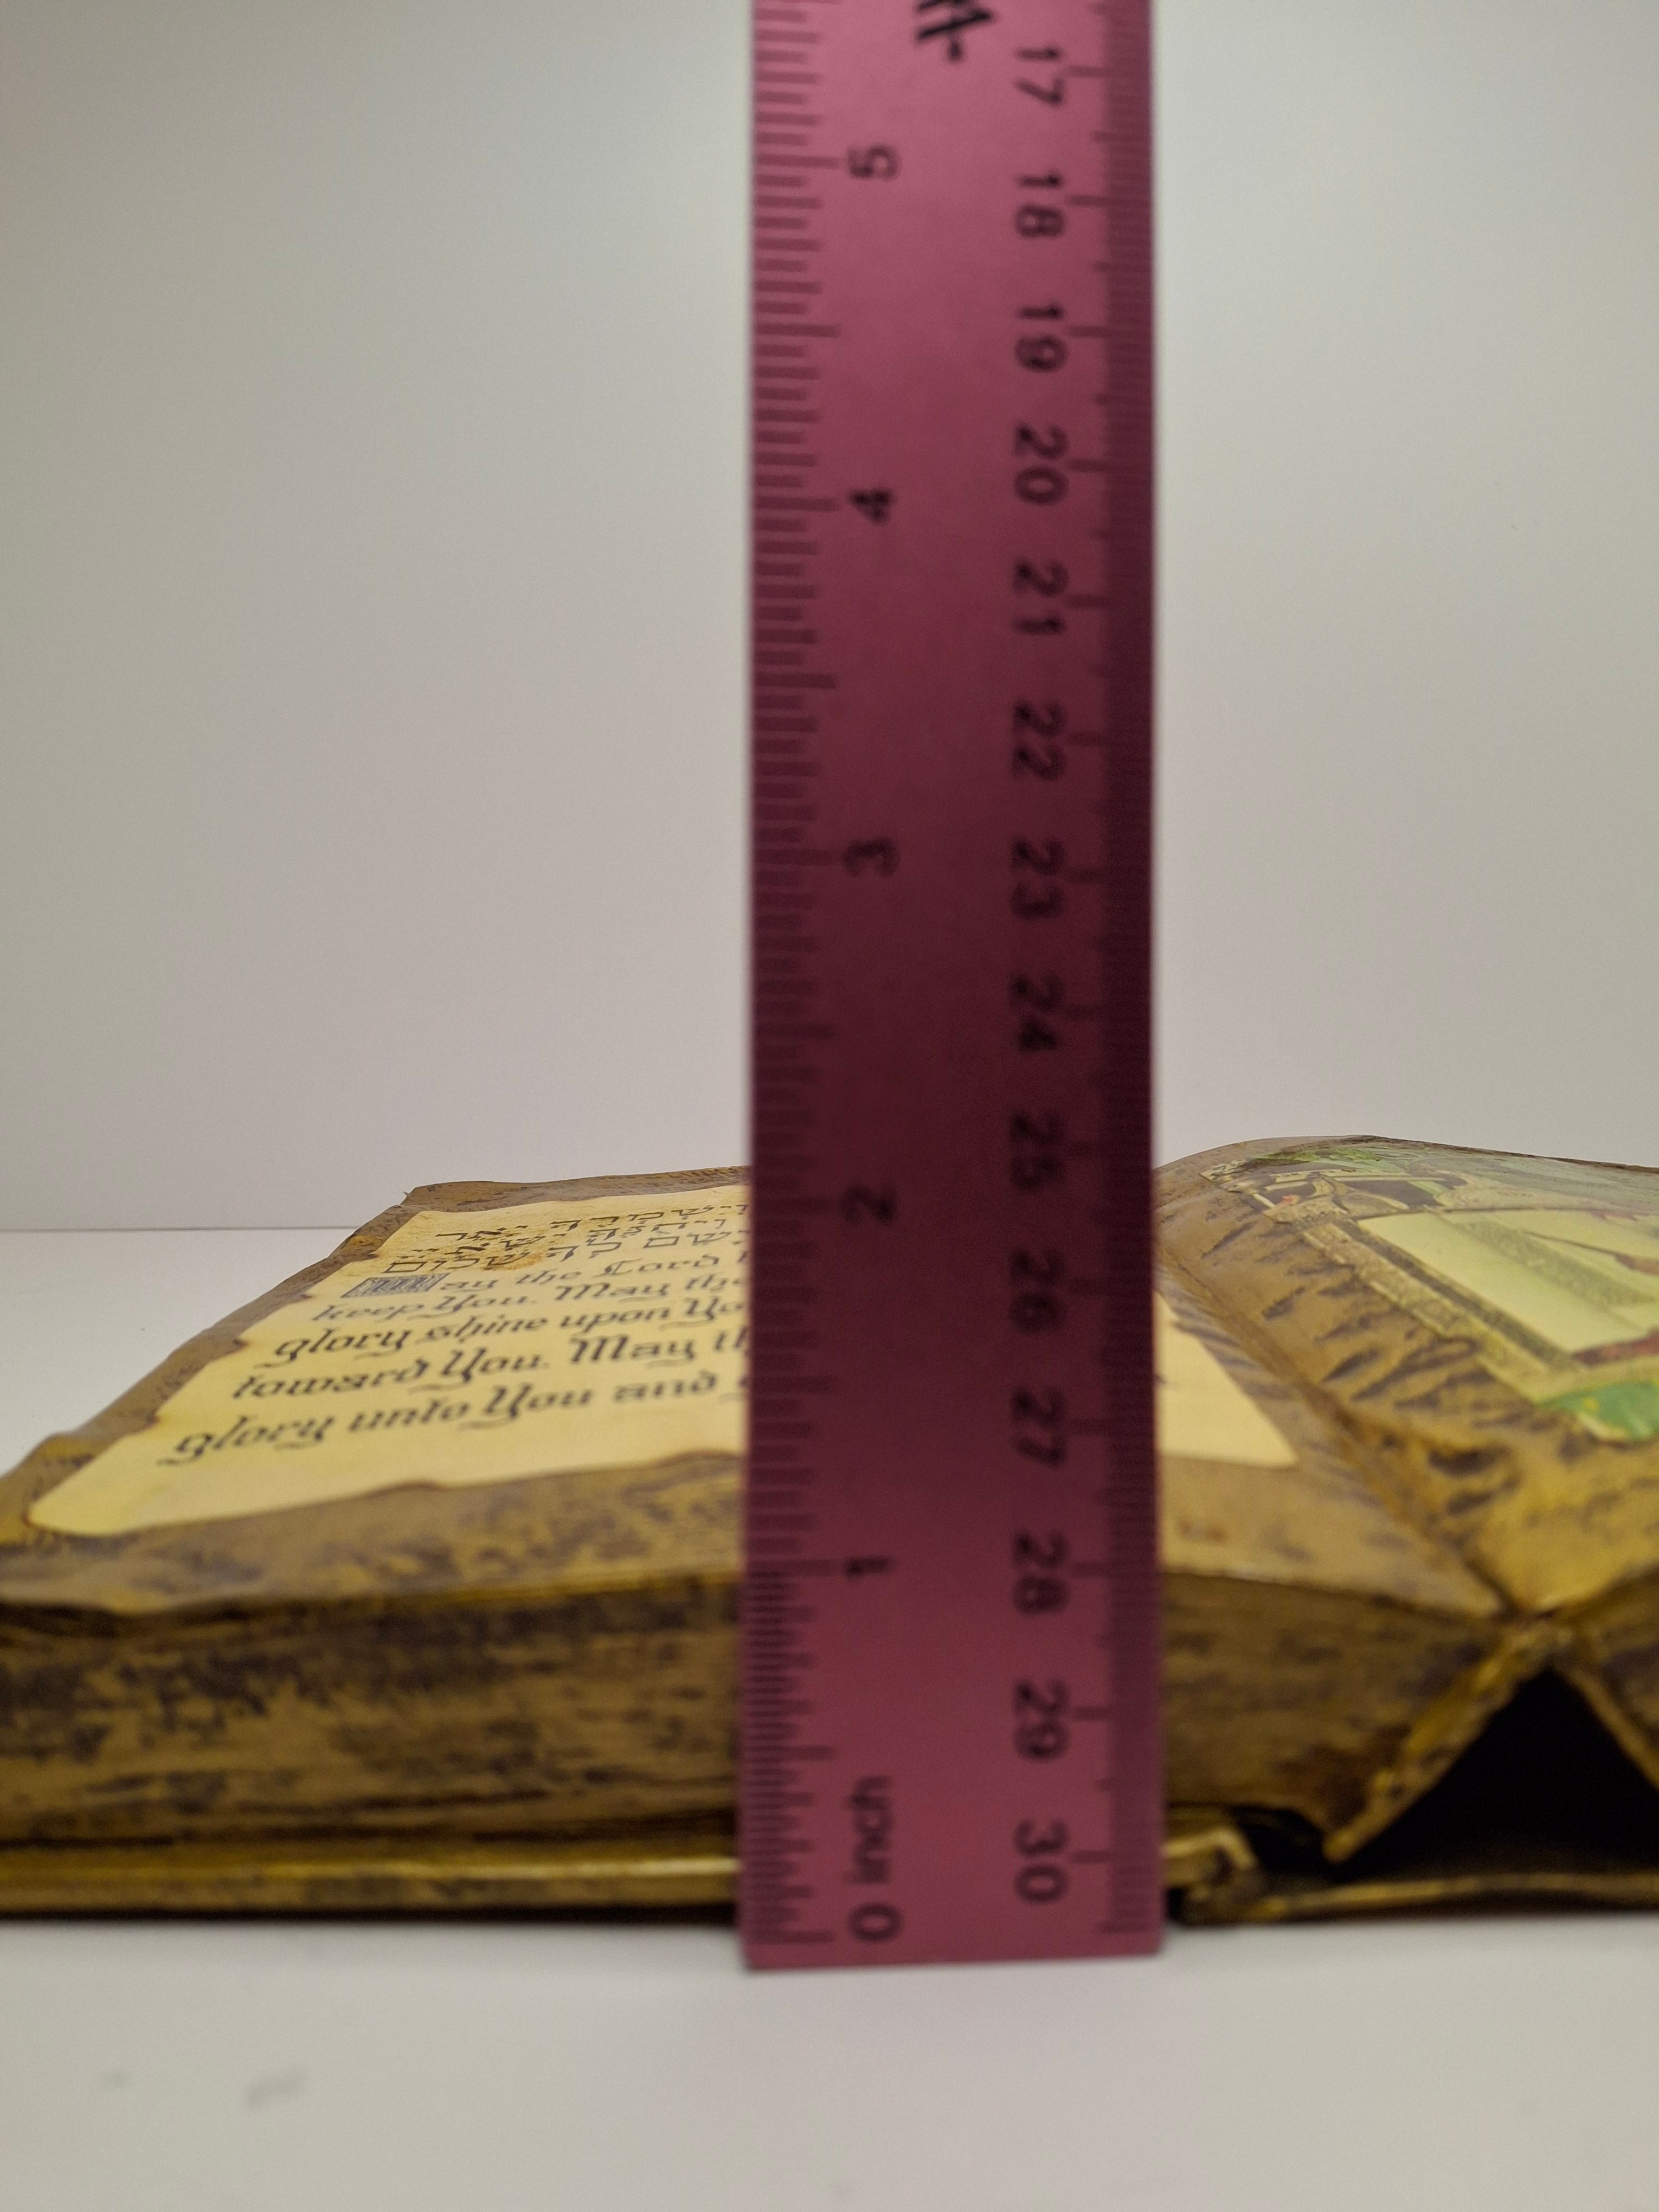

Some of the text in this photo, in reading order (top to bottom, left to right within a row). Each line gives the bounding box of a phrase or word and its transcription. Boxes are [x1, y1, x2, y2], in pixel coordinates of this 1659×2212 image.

[1014, 45, 1065, 107] 17
[845, 143, 899, 181] 5
[1013, 171, 1064, 239] 18
[1014, 303, 1065, 373] 19
[1012, 422, 1067, 506] 20
[846, 487, 896, 526] 4
[1012, 558, 1066, 635] 21
[1010, 698, 1064, 781] 22
[840, 837, 899, 877] 3
[1009, 837, 1064, 922] 23
[1008, 973, 1063, 1054] 24
[1007, 1110, 1063, 1193] 25
[839, 1186, 898, 1226] 2
[311, 1303, 425, 1323] keep
[555, 1282, 672, 1303] May
[515, 1267, 583, 1285] the
[592, 1253, 721, 1278] Lord
[1007, 1249, 1064, 1335] 26
[232, 1358, 430, 1399] toward
[569, 1333, 696, 1369] May
[253, 1326, 414, 1370] glory
[414, 1315, 548, 1344] shine
[558, 1306, 672, 1337] upon
[155, 1414, 337, 1468] glory
[347, 1398, 471, 1432] unto
[456, 1382, 594, 1432] You
[614, 1369, 718, 1404] and
[1009, 1386, 1066, 1468] 27
[842, 1555, 895, 1581] 1
[1012, 1530, 1068, 1616] 28
[1013, 1680, 1069, 1763] 29
[845, 1774, 895, 1886] inch
[1012, 1819, 1069, 1906] 30
[847, 1901, 904, 1946] 0
